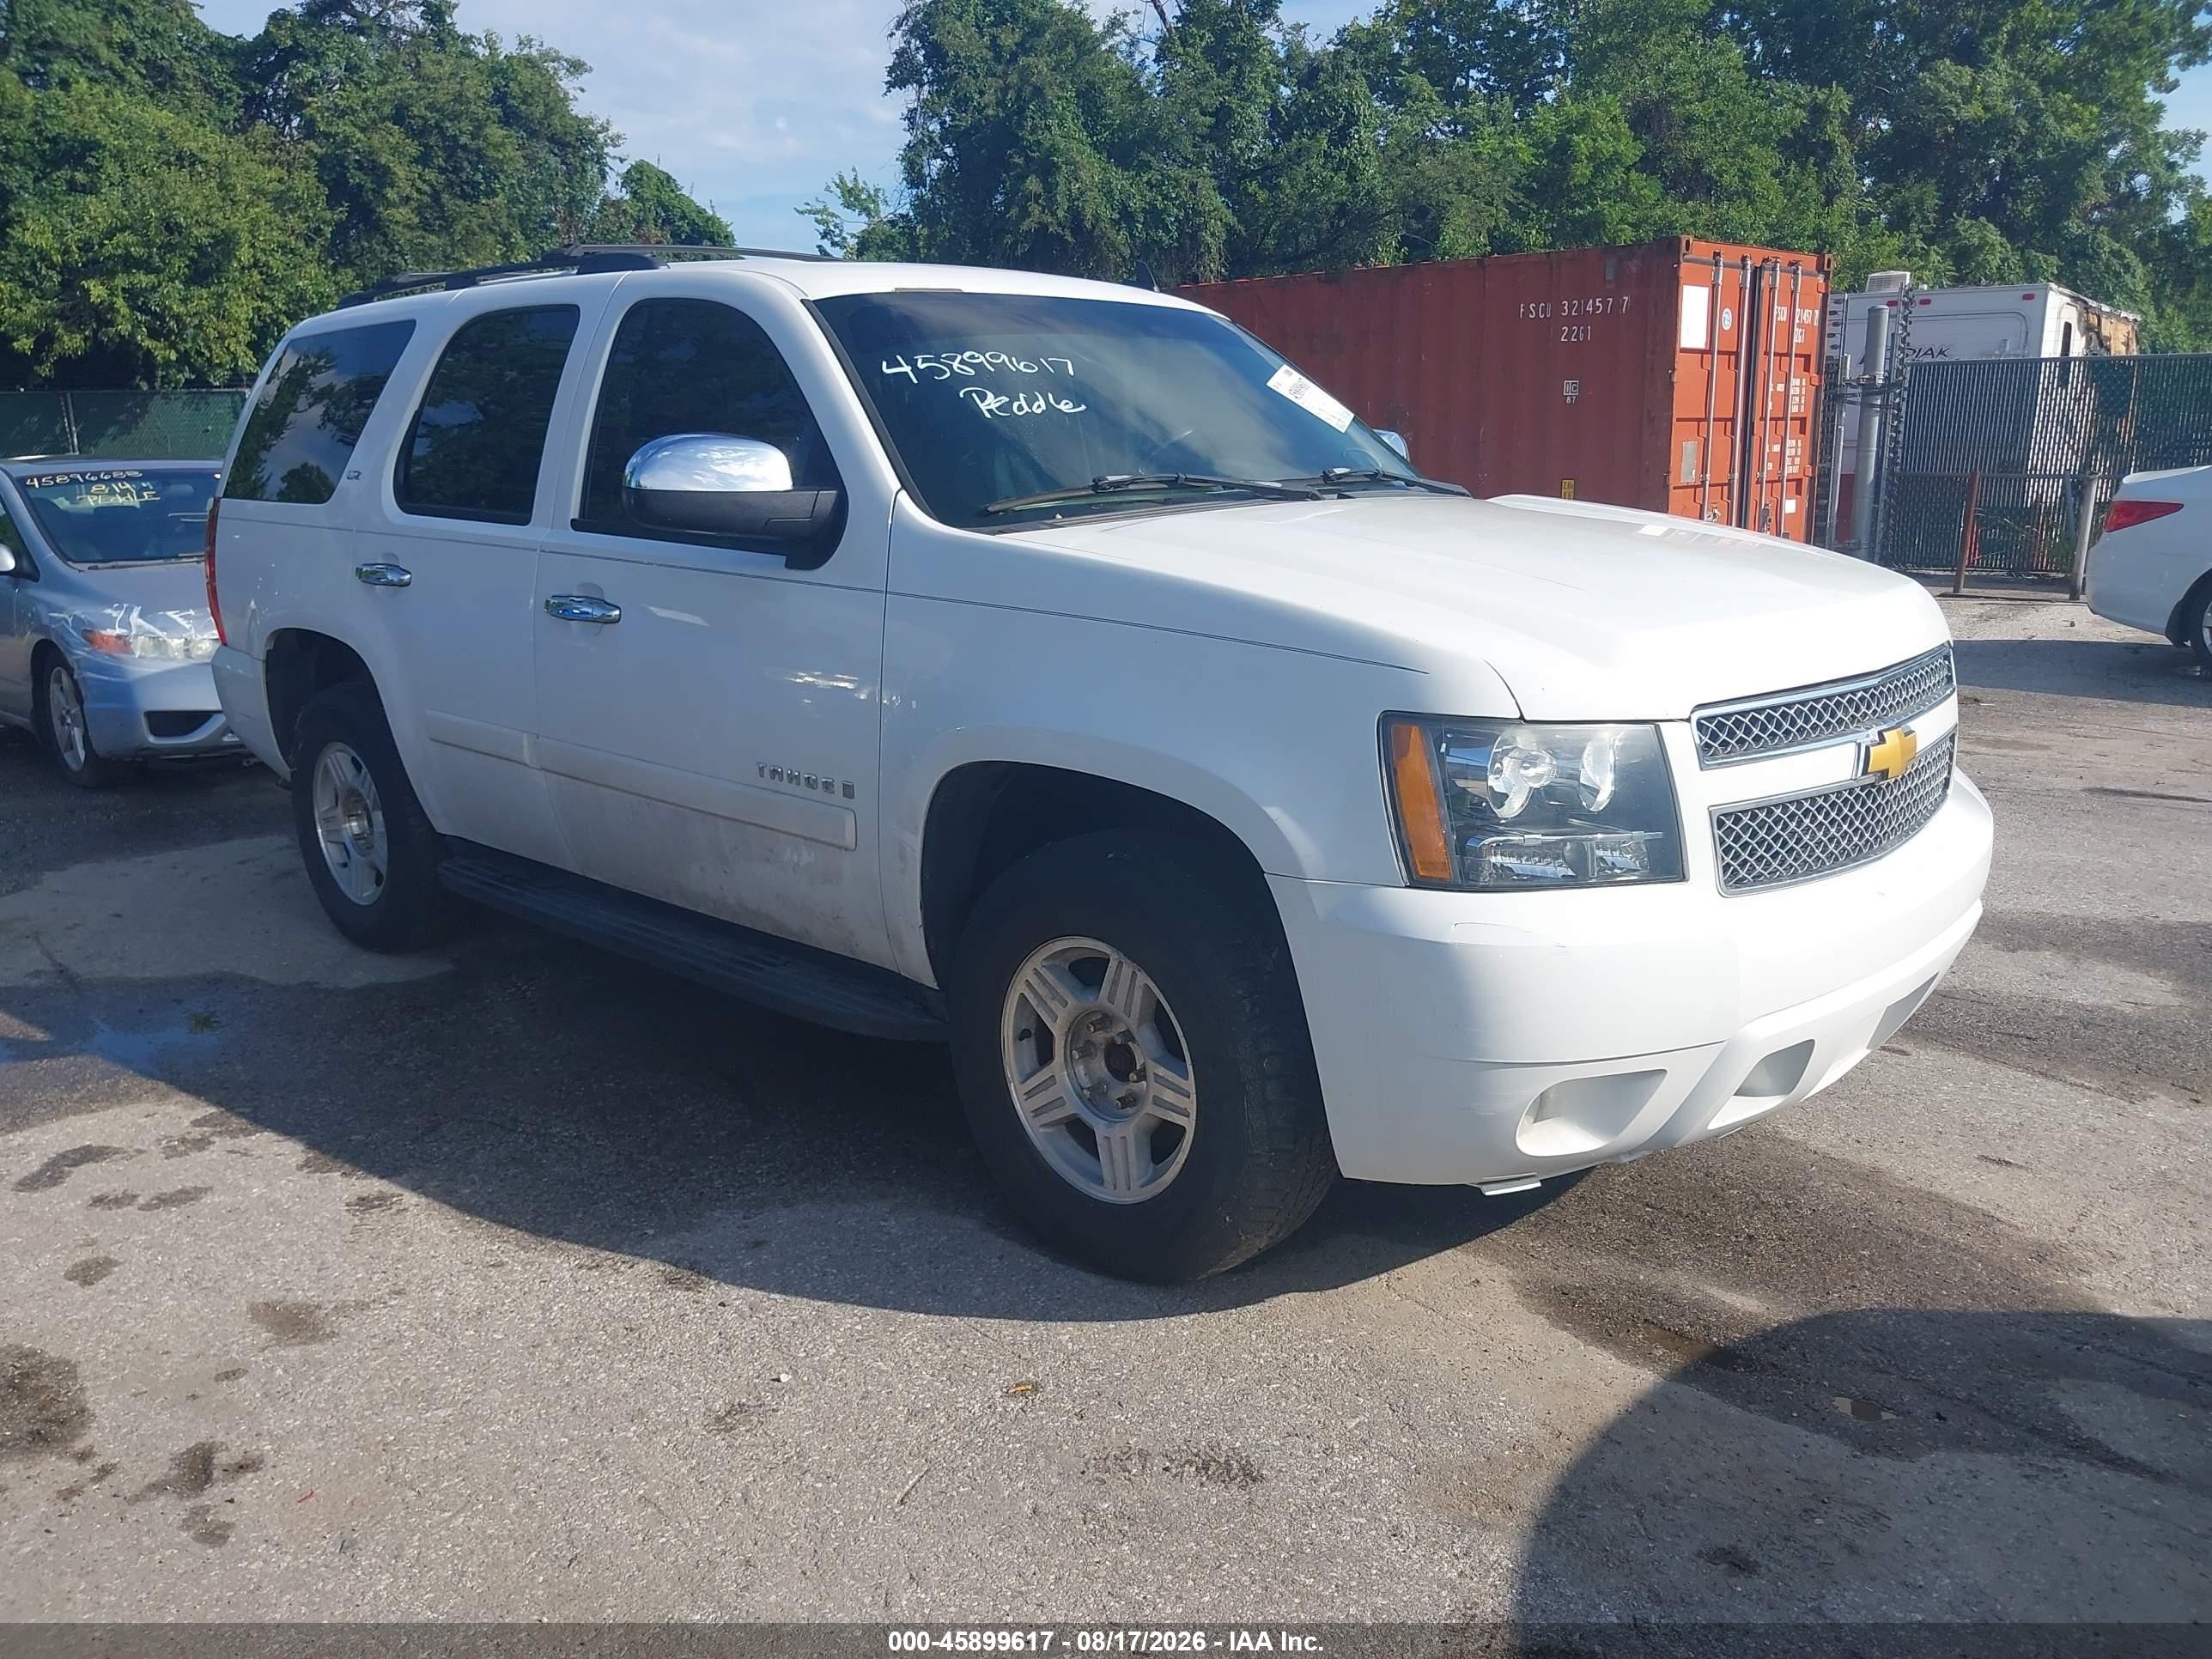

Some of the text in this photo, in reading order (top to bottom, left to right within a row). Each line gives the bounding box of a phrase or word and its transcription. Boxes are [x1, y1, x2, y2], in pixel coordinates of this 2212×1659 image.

[1520, 302, 1552, 319] FSCU
[1561, 297, 1613, 316] 321457
[1796, 308, 1813, 325] 21457
[1794, 328, 1805, 344] 2G1
[882, 350, 1074, 384] 45899617
[959, 387, 1087, 419] Peddle
[757, 762, 835, 794] TAHOE
